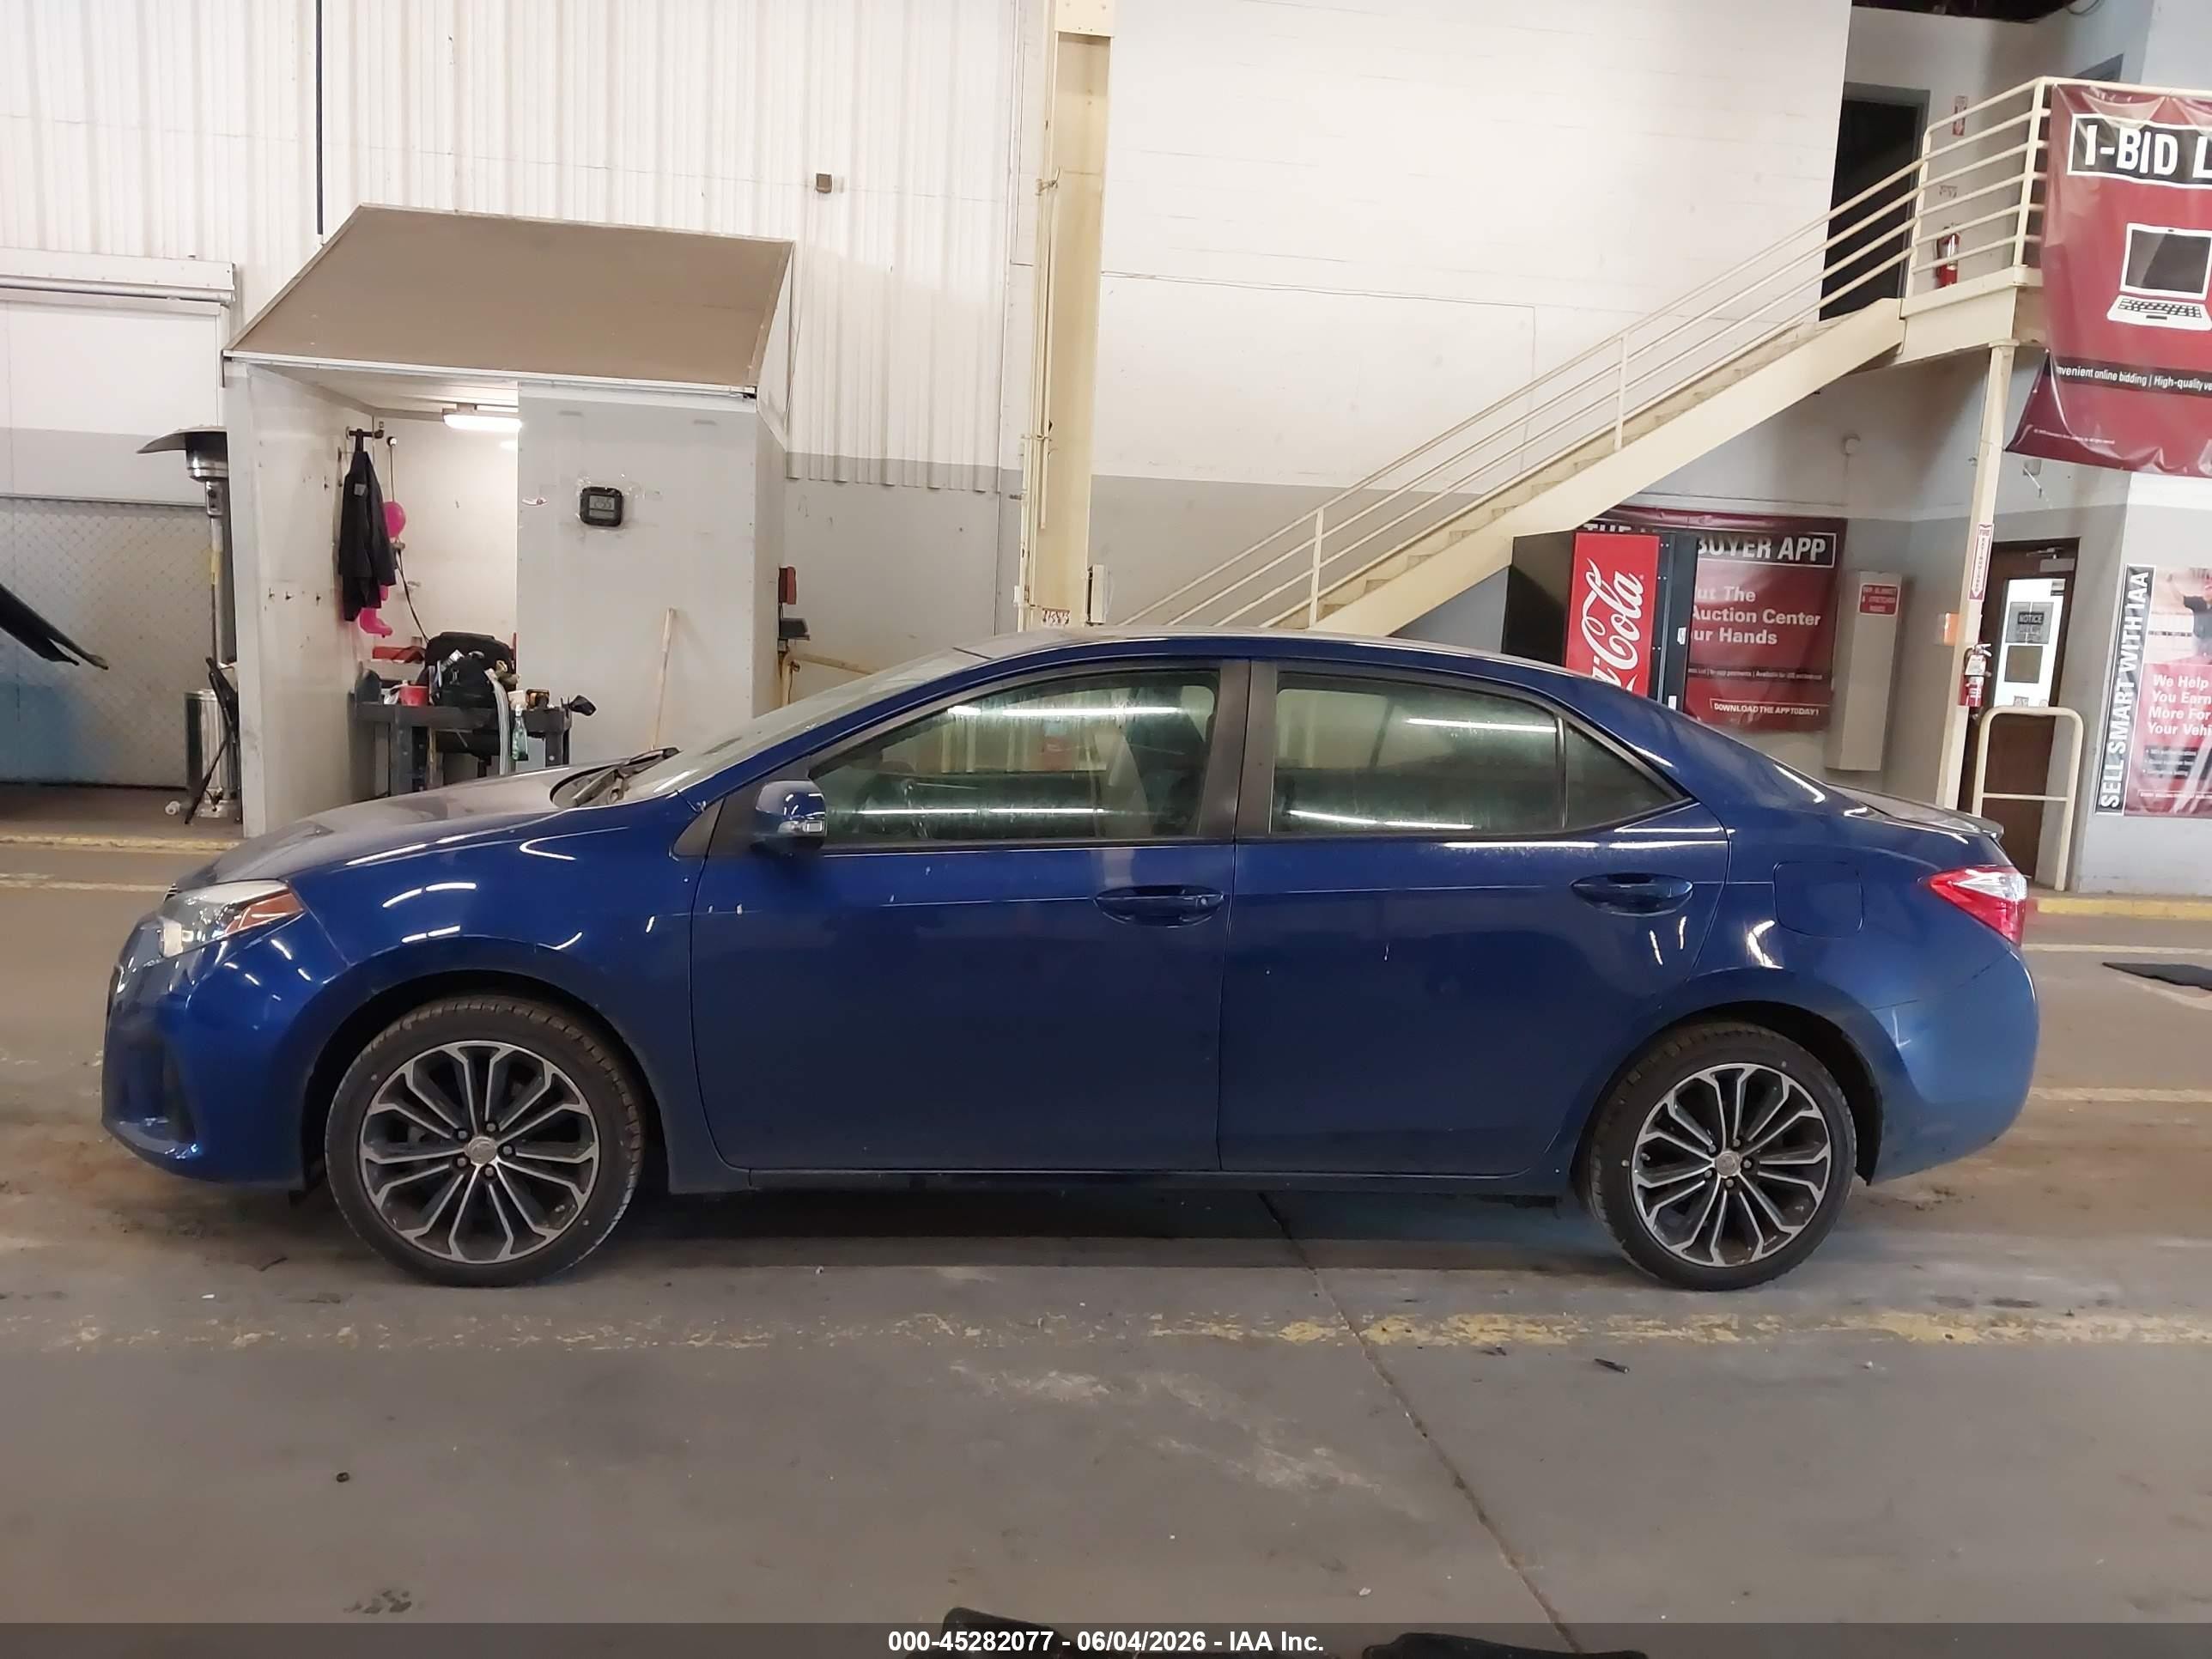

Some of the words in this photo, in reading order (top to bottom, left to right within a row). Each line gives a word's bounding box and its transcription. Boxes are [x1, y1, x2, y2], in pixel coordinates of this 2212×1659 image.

[2085, 125, 2179, 175] I-BID
[2094, 368, 2118, 381] online
[2118, 371, 2147, 386] bidding
[2154, 374, 2203, 392] High-quality
[1777, 536, 1826, 562] APP
[1695, 587, 1716, 600] ut
[1723, 586, 1756, 603] The
[2125, 572, 2149, 609] IAA
[1692, 605, 1757, 623] Auction
[1762, 608, 1820, 626] Center
[2019, 614, 2042, 623] NOTICE
[1691, 629, 1713, 641] ur
[1719, 627, 1778, 645] Hands
[2119, 616, 2143, 673] WITH
[2153, 674, 2174, 688] We
[2178, 675, 2209, 691] Help
[2152, 690, 2177, 702] You
[2181, 691, 2212, 704] Earn
[1714, 703, 1759, 714] DOWNLOAD
[2108, 677, 2134, 754] SMART
[2148, 706, 2185, 720] More
[2188, 708, 2211, 720] For
[2147, 721, 2178, 735] Your
[2100, 759, 2124, 807] SELL
